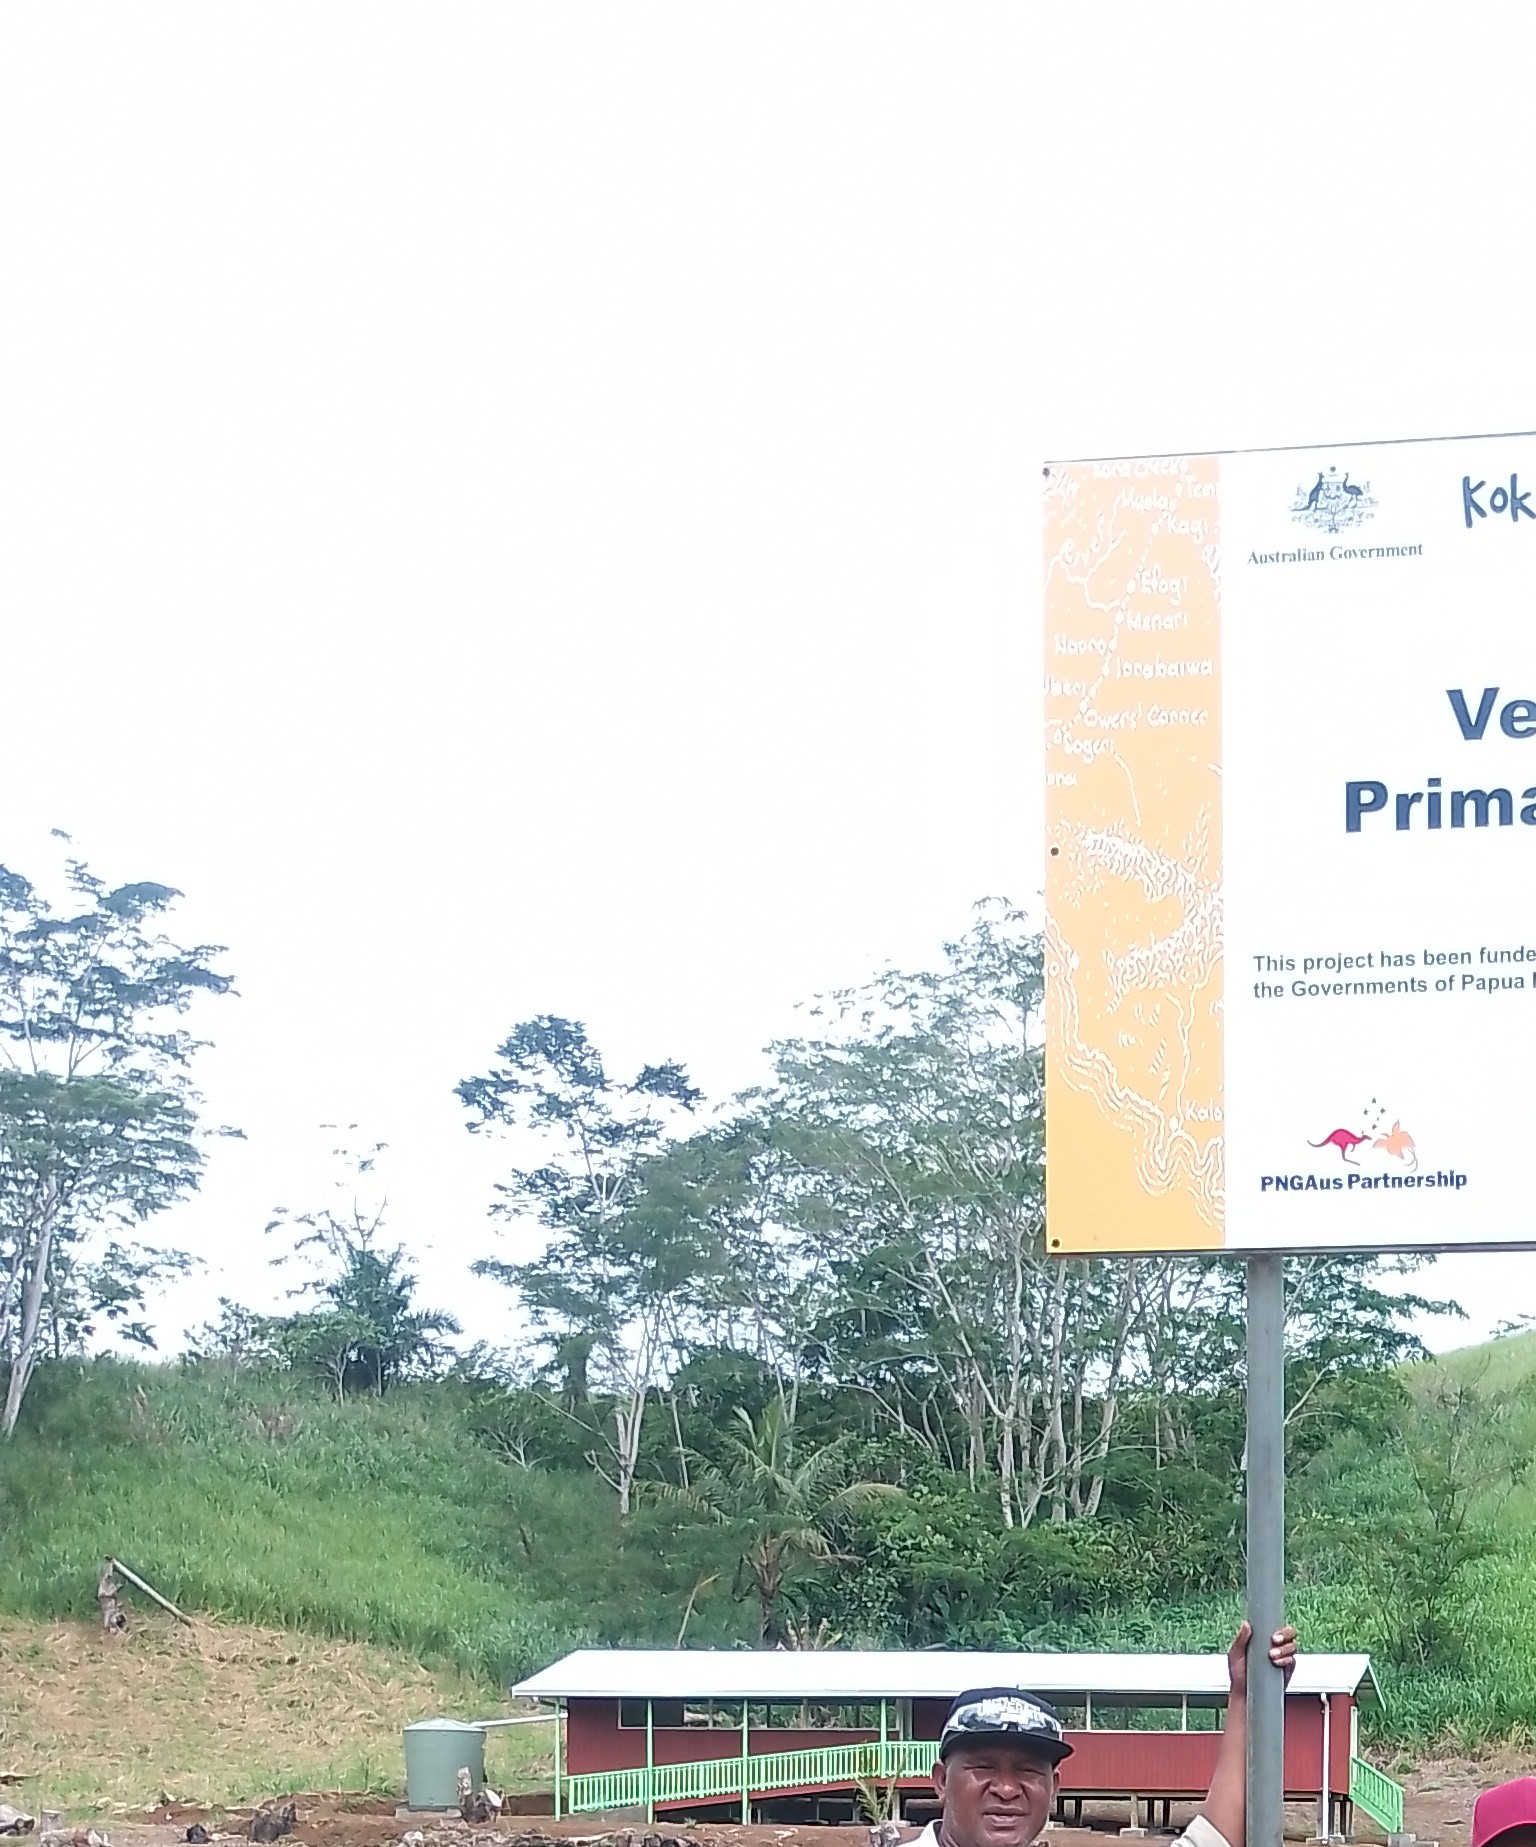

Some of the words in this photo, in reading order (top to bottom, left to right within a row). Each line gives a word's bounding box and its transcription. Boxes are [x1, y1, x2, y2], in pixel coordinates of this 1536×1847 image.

[1248, 547, 1324, 564] Australian
[1329, 544, 1423, 560] Government
[1253, 955, 1295, 972] This
[1304, 953, 1374, 975] project
[1381, 951, 1415, 967] has
[1424, 949, 1471, 965] been
[1254, 982, 1284, 998] the
[1292, 977, 1427, 996] Governments
[1435, 975, 1455, 991] of
[1462, 974, 1524, 994] Papua
[1261, 1175, 1343, 1192] PNGAus
[1348, 1170, 1467, 1190] Partnership
